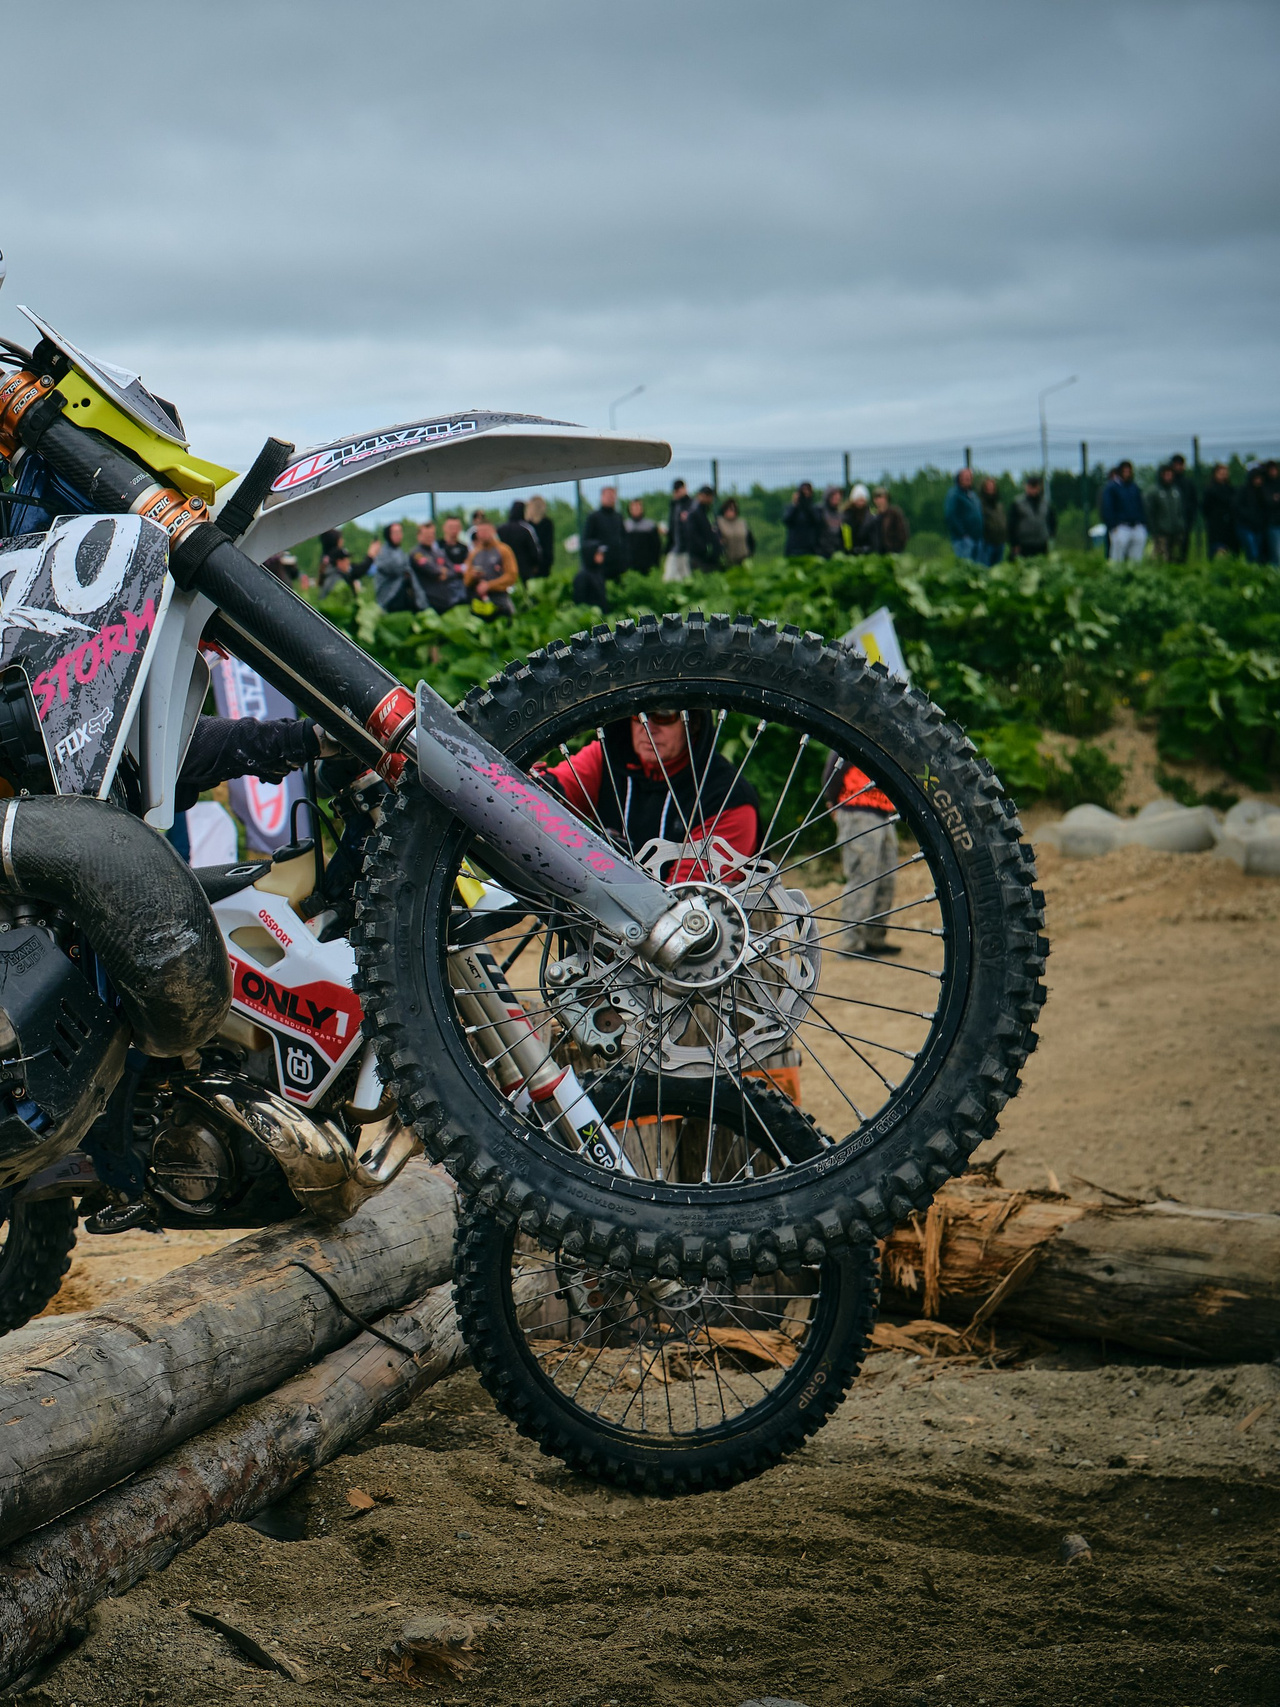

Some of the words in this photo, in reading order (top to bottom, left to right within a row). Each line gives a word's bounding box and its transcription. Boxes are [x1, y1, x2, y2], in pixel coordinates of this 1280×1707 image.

[13, 387, 40, 415] ROCS
[168, 508, 193, 536] OCS
[33, 598, 157, 722] STORM
[54, 727, 92, 764] FOX
[258, 909, 293, 948] OSSPORT
[464, 956, 482, 980] XACT
[244, 999, 278, 1022] EXTREME
[279, 1017, 312, 1035] ENDURO
[314, 1031, 343, 1045] PARTS
[876, 1110, 901, 1134] DID
